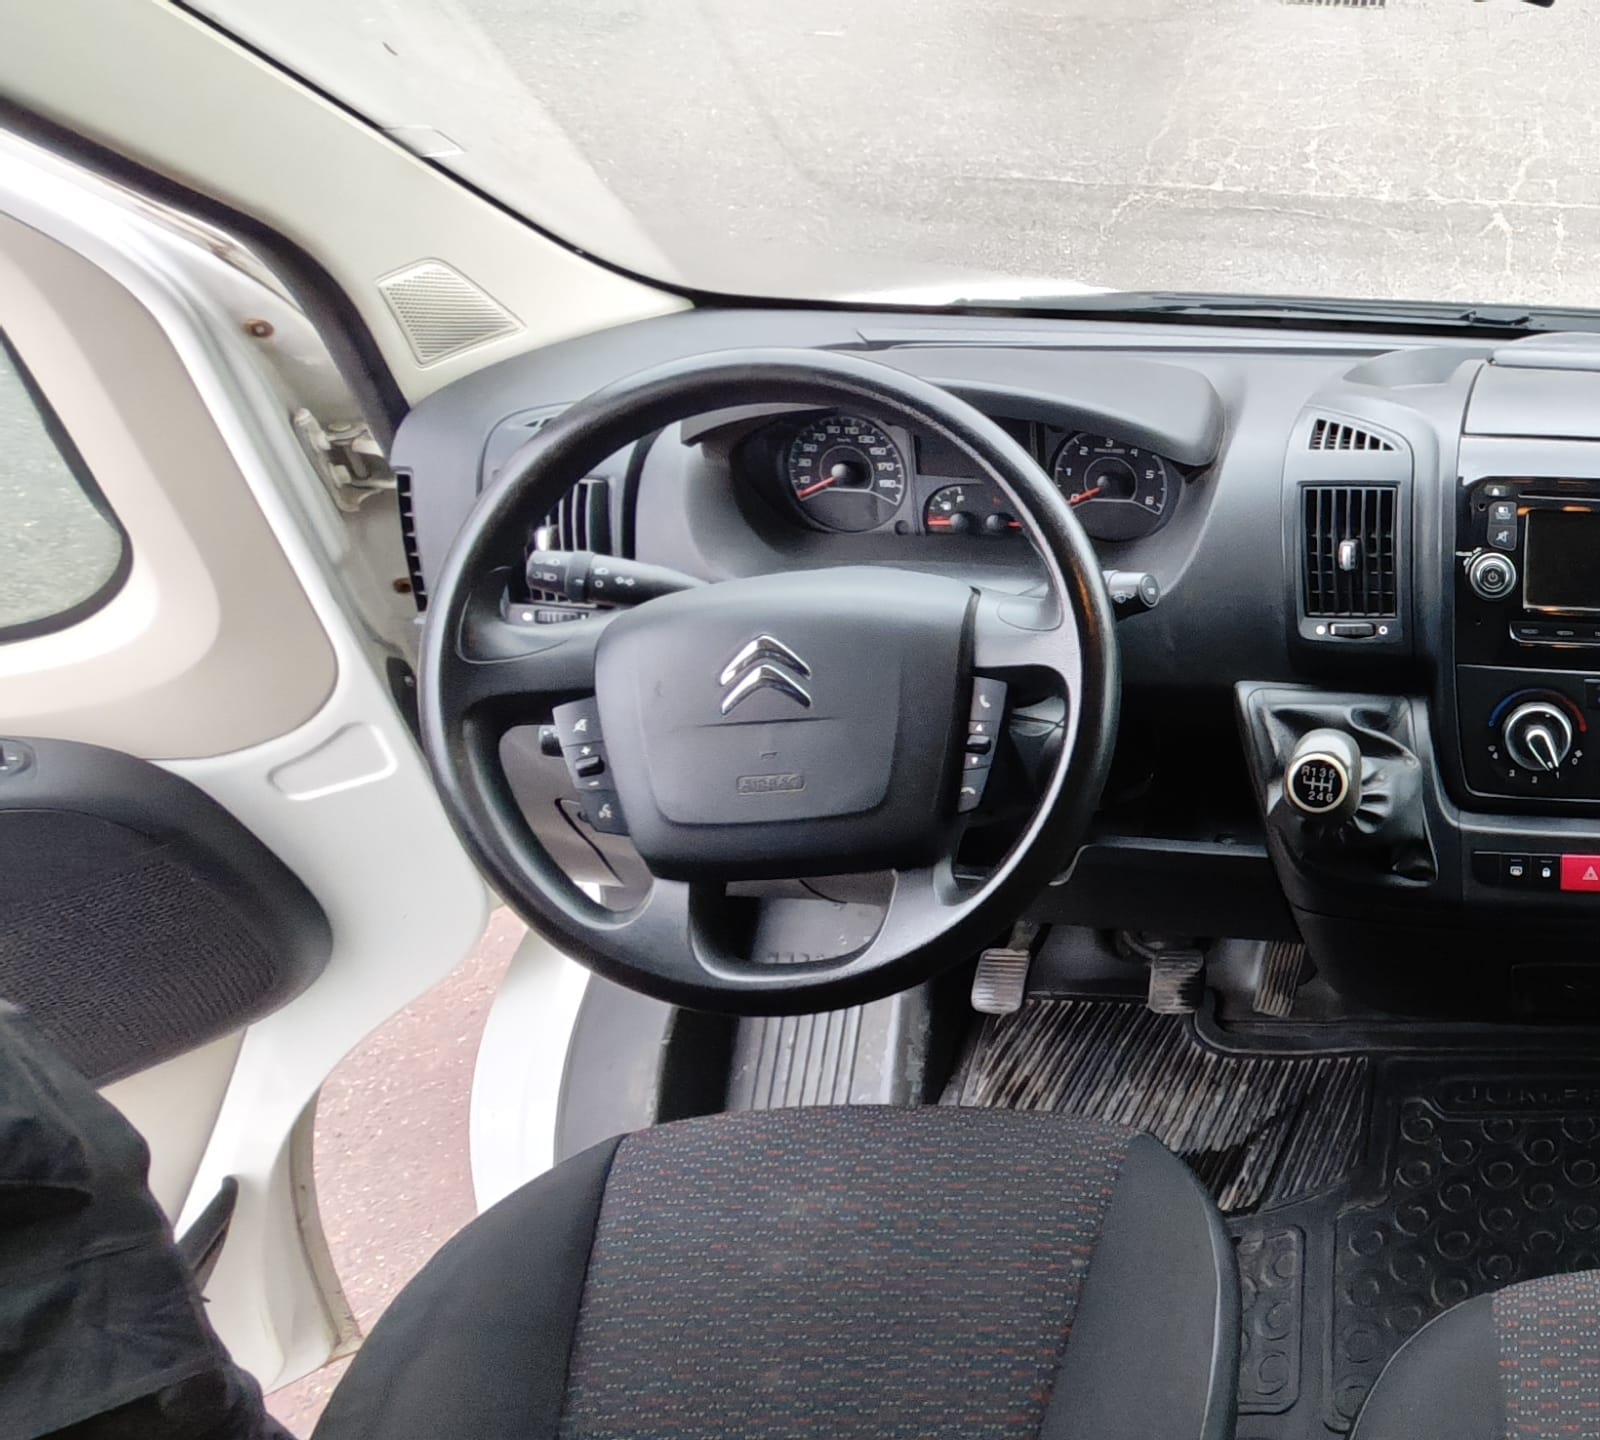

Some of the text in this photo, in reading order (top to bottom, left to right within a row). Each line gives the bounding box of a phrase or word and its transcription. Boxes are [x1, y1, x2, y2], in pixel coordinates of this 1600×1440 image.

[813, 432, 826, 441] 70
[1105, 438, 1114, 447] 3
[1079, 446, 1089, 455] 2
[1130, 449, 1138, 457] 4
[877, 462, 894, 471] 170
[1066, 467, 1072, 476] 1
[1145, 469, 1155, 479] 5
[800, 475, 811, 484] 10
[1144, 496, 1154, 506] 6
[1492, 752, 1498, 760] 4
[1301, 765, 1310, 776] R
[1311, 767, 1317, 777] 1
[1319, 767, 1327, 778] 3
[1508, 769, 1515, 777] 3
[1531, 776, 1538, 784] 2
[1308, 790, 1334, 803] 2 4 6
